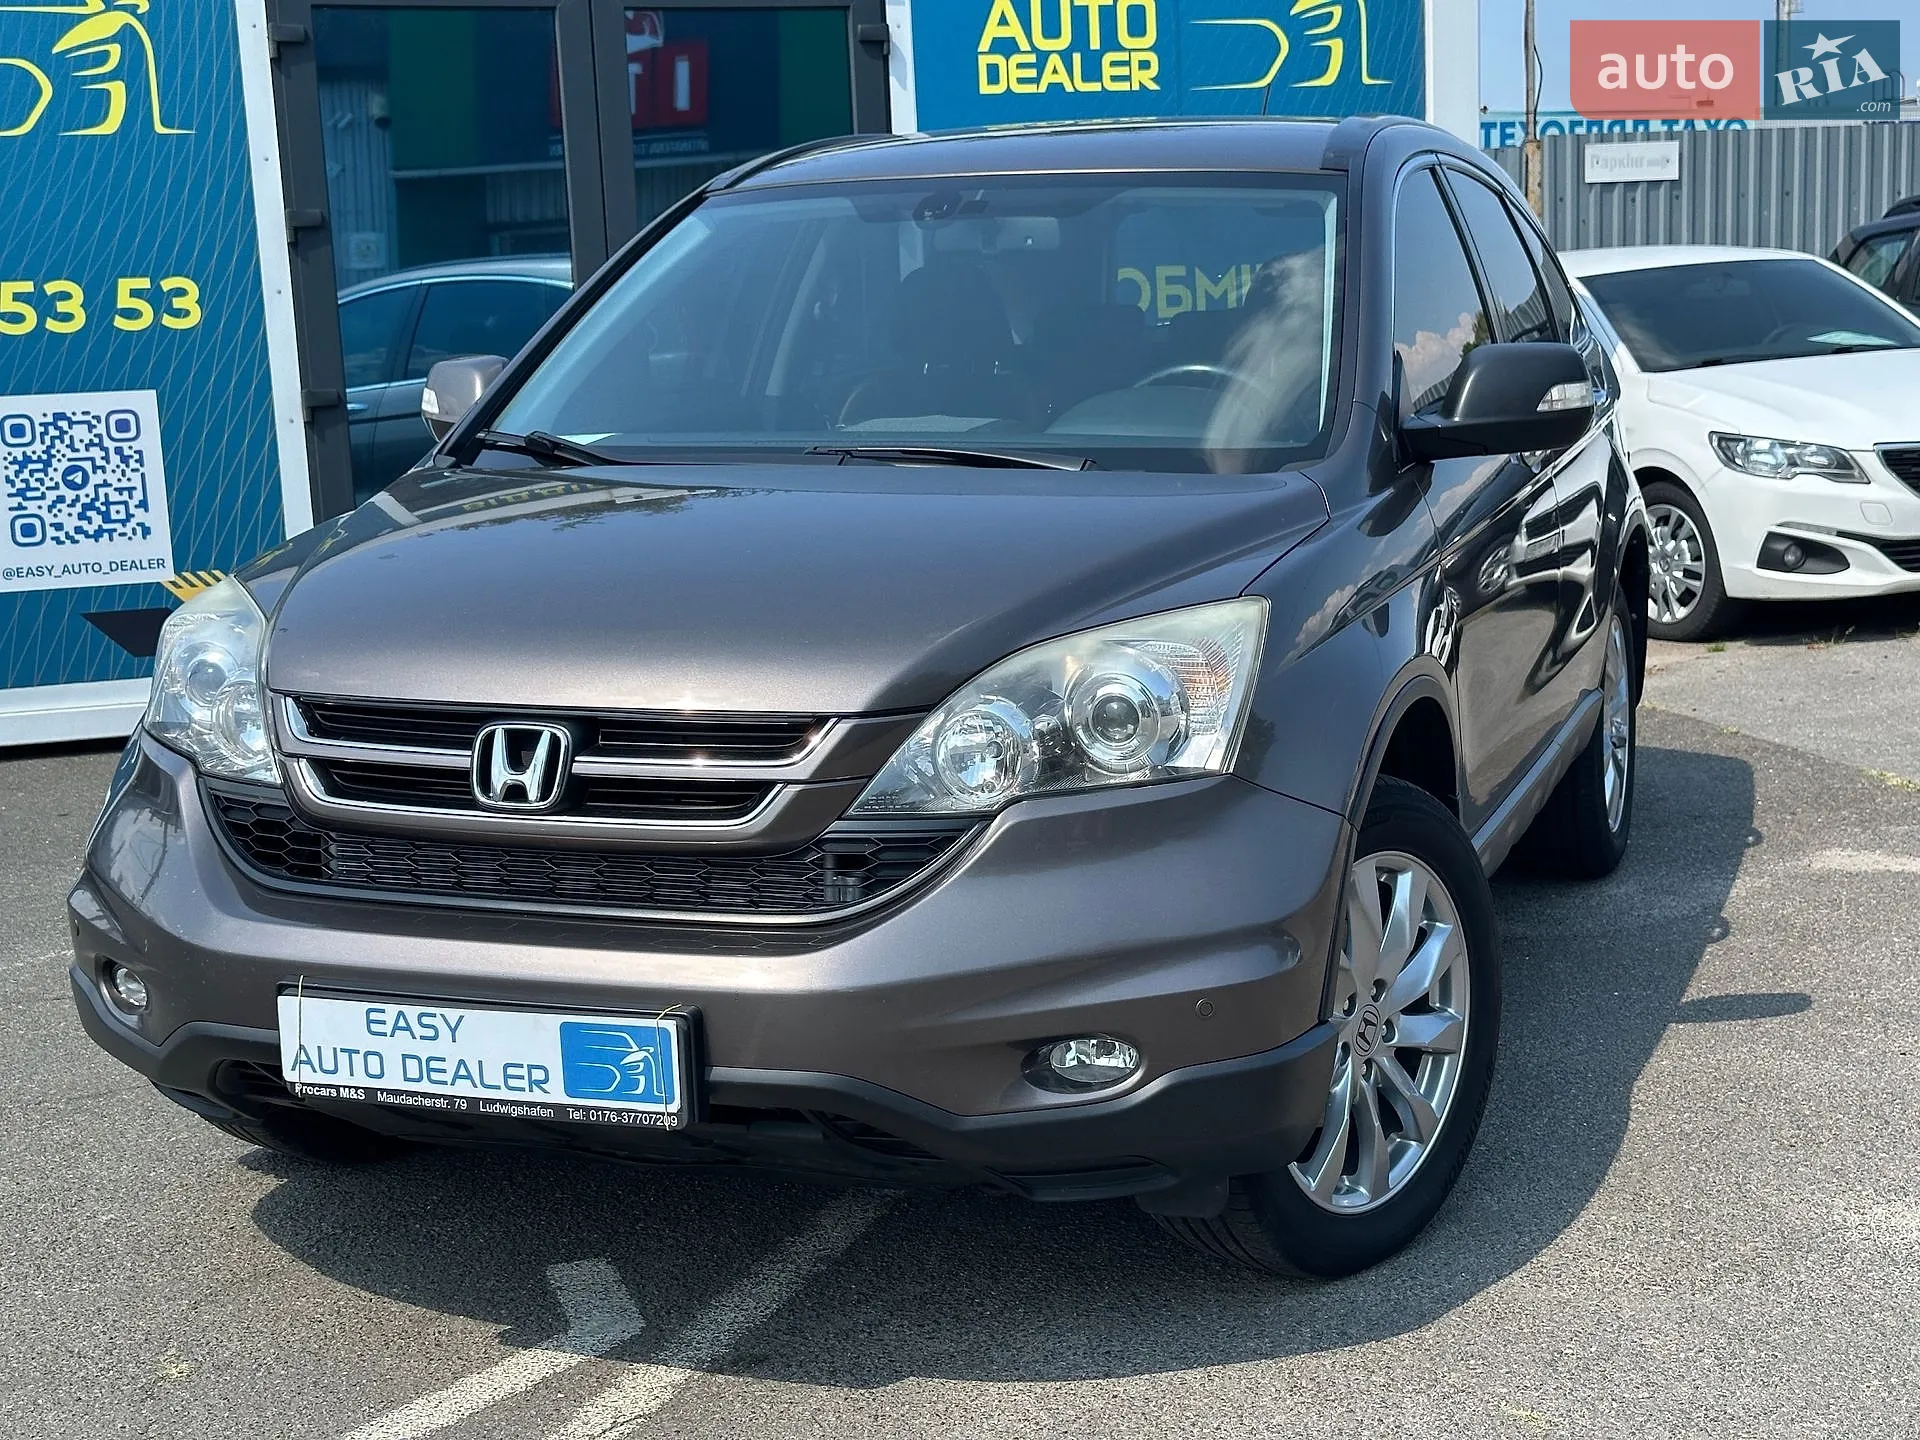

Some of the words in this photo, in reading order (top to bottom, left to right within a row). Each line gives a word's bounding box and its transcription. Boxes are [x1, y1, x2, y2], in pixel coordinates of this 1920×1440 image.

[977, 0, 1158, 52] AUTO
[978, 52, 1161, 94] DEALER
[0, 279, 87, 336] 53
[113, 276, 203, 332] 53
[2, 558, 166, 581] @EASY_AUTO_DEALER
[365, 1007, 465, 1043] EASY
[291, 1044, 386, 1080] AUTO
[401, 1053, 551, 1095] DEALER
[294, 1083, 337, 1098] Procars
[340, 1087, 366, 1100] M&S
[377, 1091, 451, 1109] Maudacherstr.
[454, 1098, 468, 1110] 79
[479, 1100, 554, 1118] Ludwigshafen
[566, 1107, 586, 1121] Tel:
[589, 1109, 678, 1127] 0176-37707209
